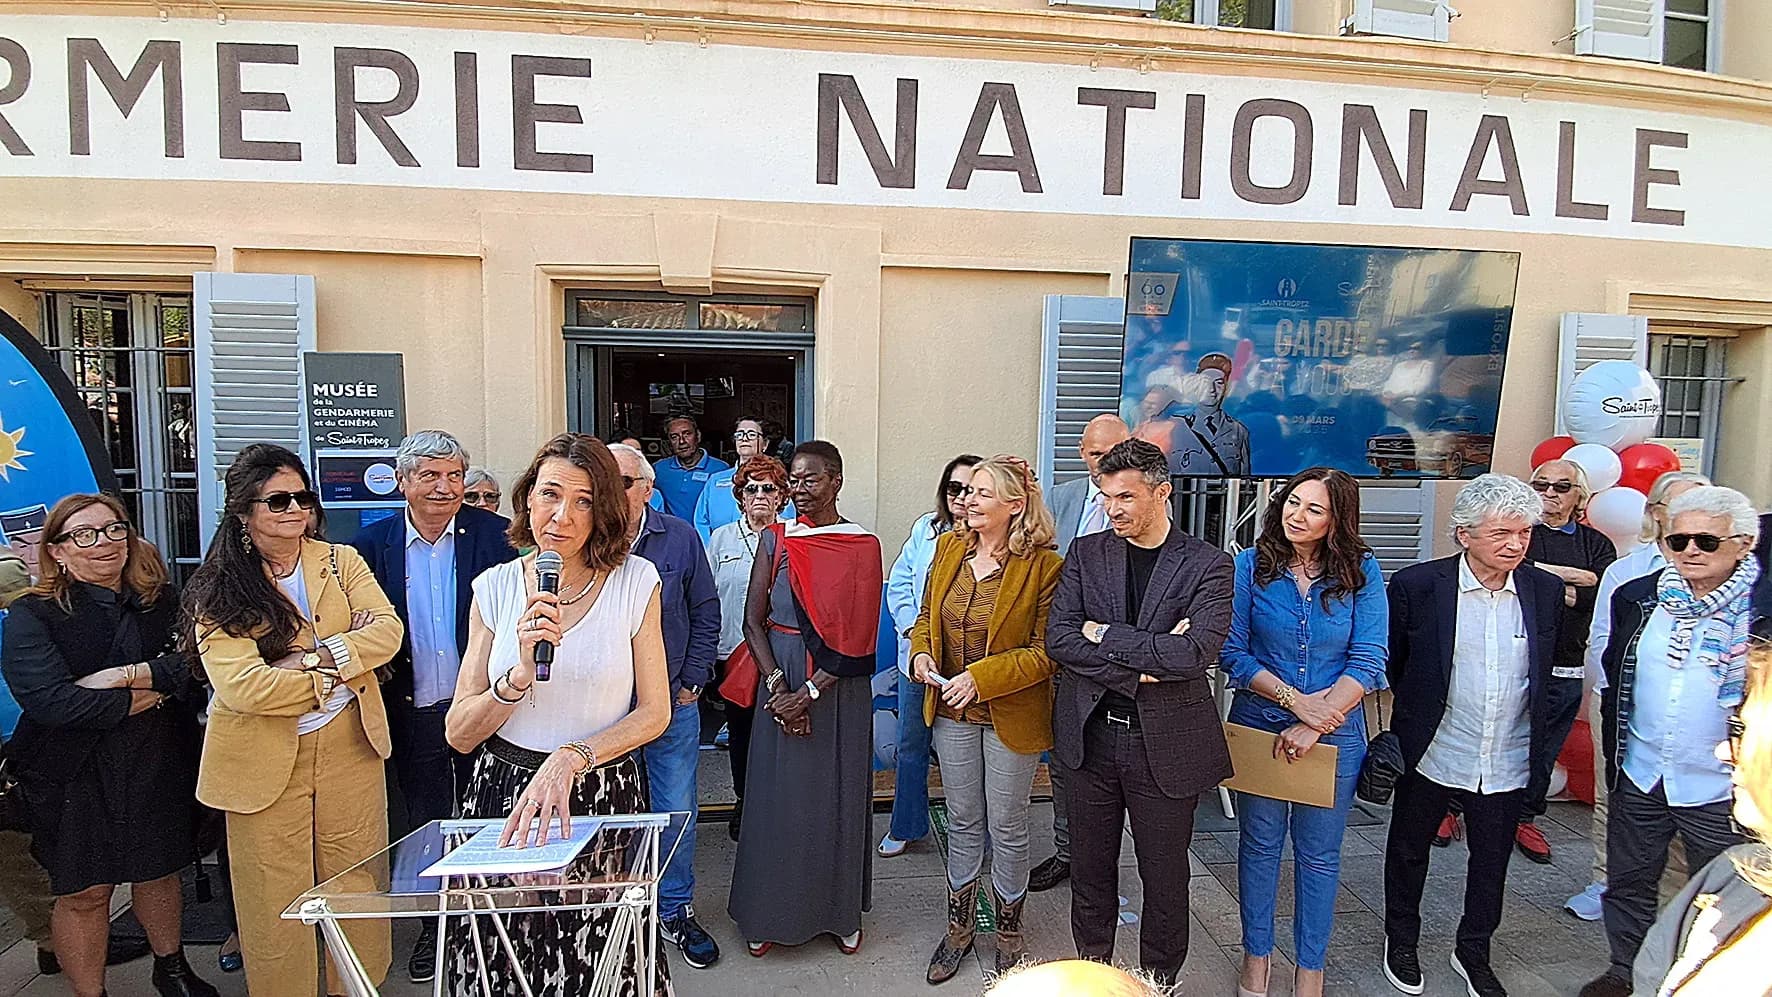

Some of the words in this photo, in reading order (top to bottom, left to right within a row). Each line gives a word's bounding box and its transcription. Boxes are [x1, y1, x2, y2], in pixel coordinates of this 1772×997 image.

[816, 73, 1689, 226] NATIONALE
[1274, 318, 1370, 358] GARDE
[312, 381, 378, 397] MUSÉE
[312, 398, 324, 406] de
[325, 398, 334, 406] la
[313, 408, 395, 418] GENDARMERIE
[324, 419, 336, 427] du
[337, 417, 379, 427] CINÉMA
[1306, 416, 1336, 425] MARS
